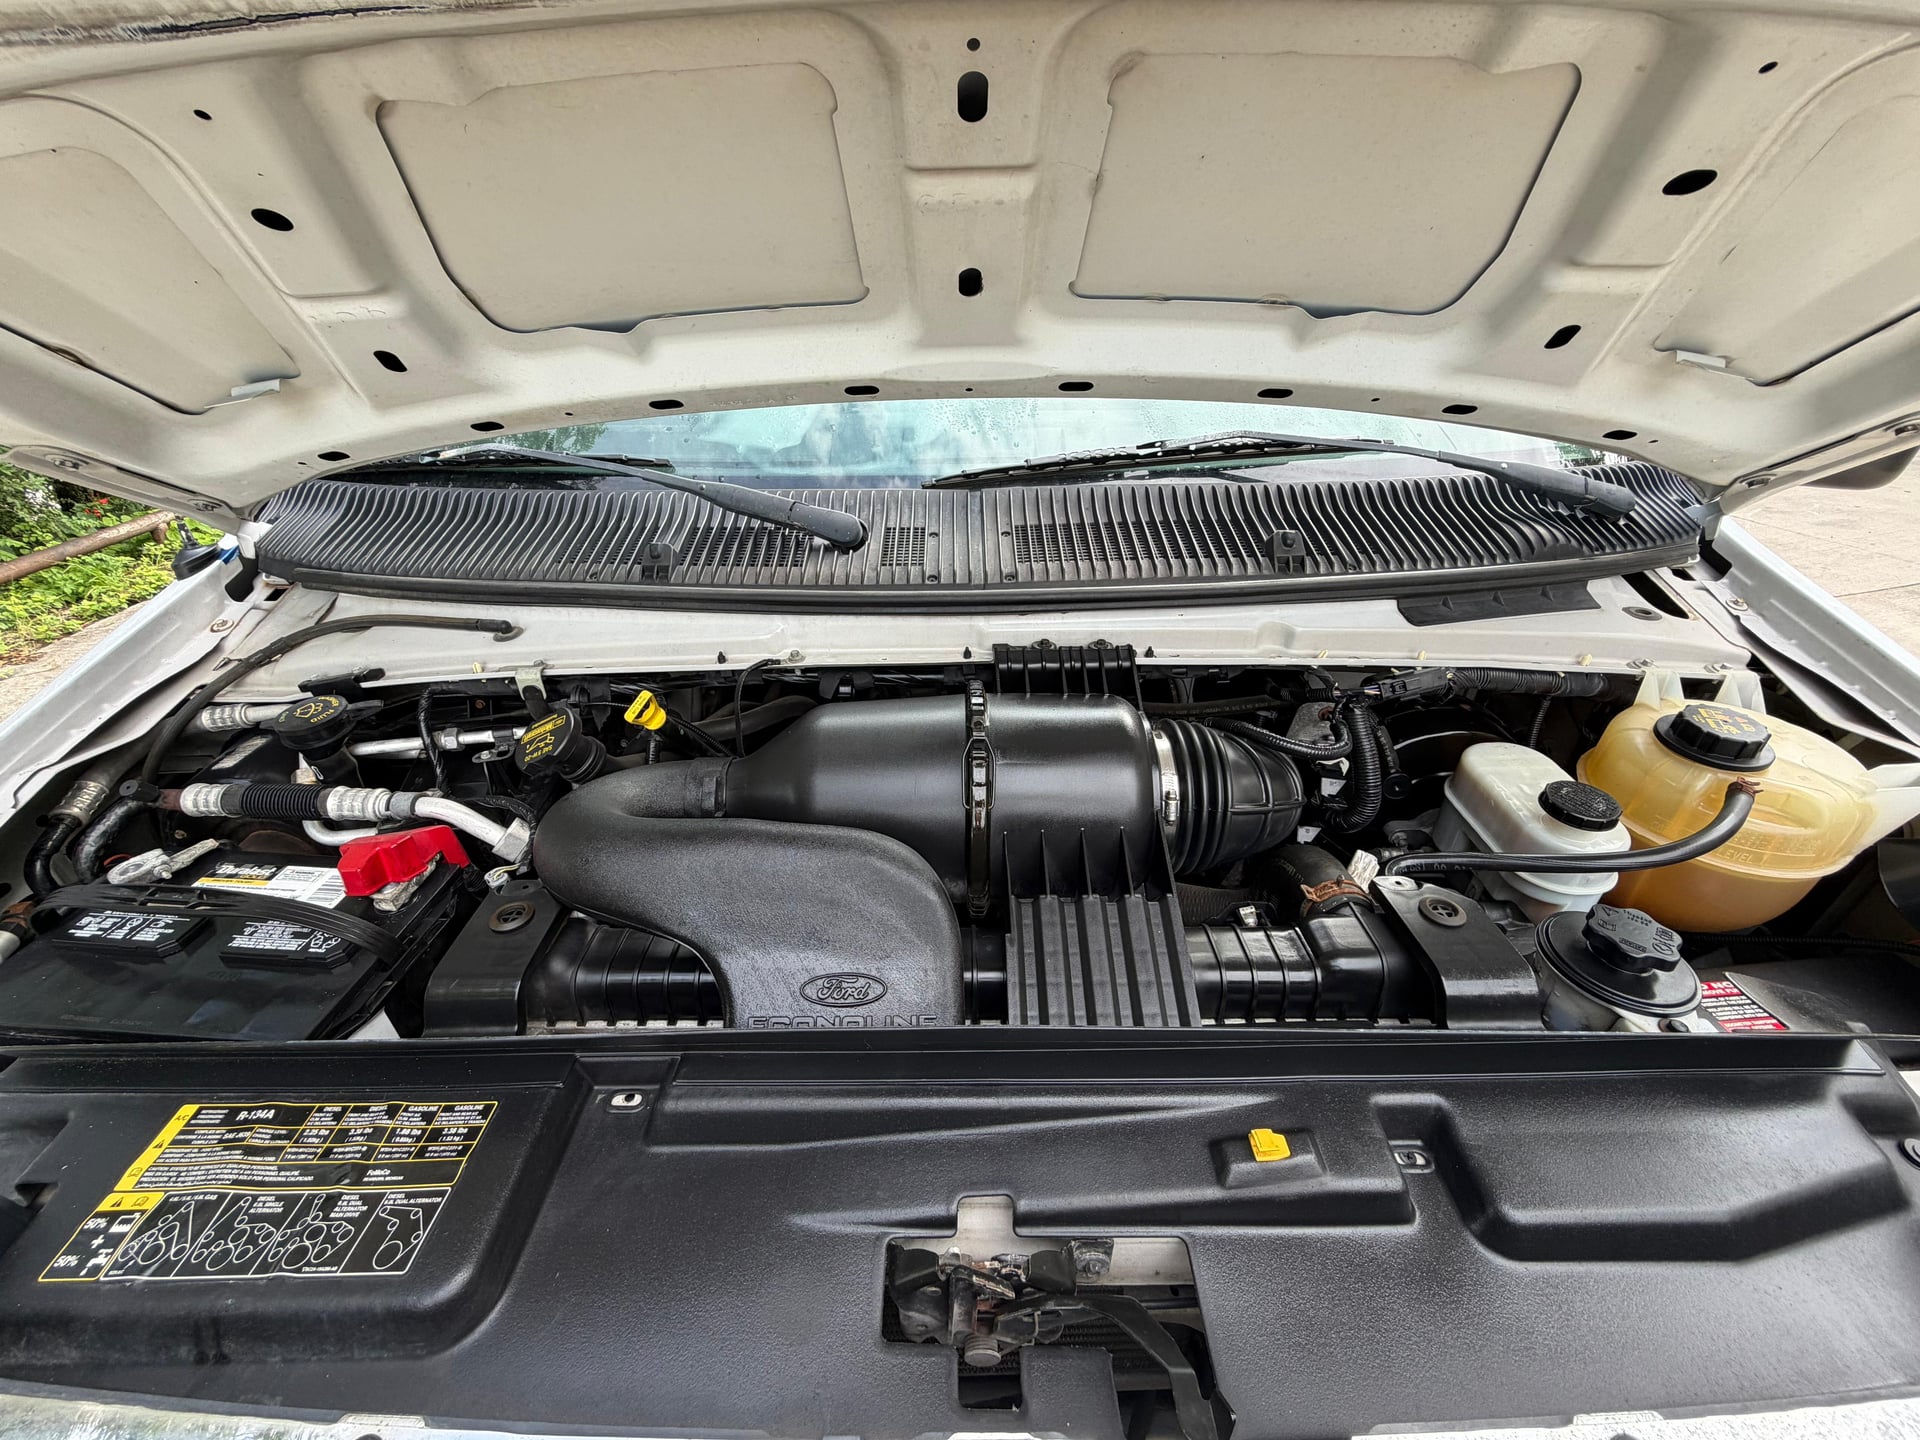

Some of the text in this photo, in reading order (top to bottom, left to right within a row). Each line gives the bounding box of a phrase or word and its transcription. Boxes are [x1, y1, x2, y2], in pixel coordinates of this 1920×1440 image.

[817, 976, 871, 1000] Ford
[236, 1109, 276, 1121] R-134A
[222, 1132, 236, 1140] SAE
[83, 1217, 110, 1229] 50%
[53, 1255, 80, 1267] 50%
